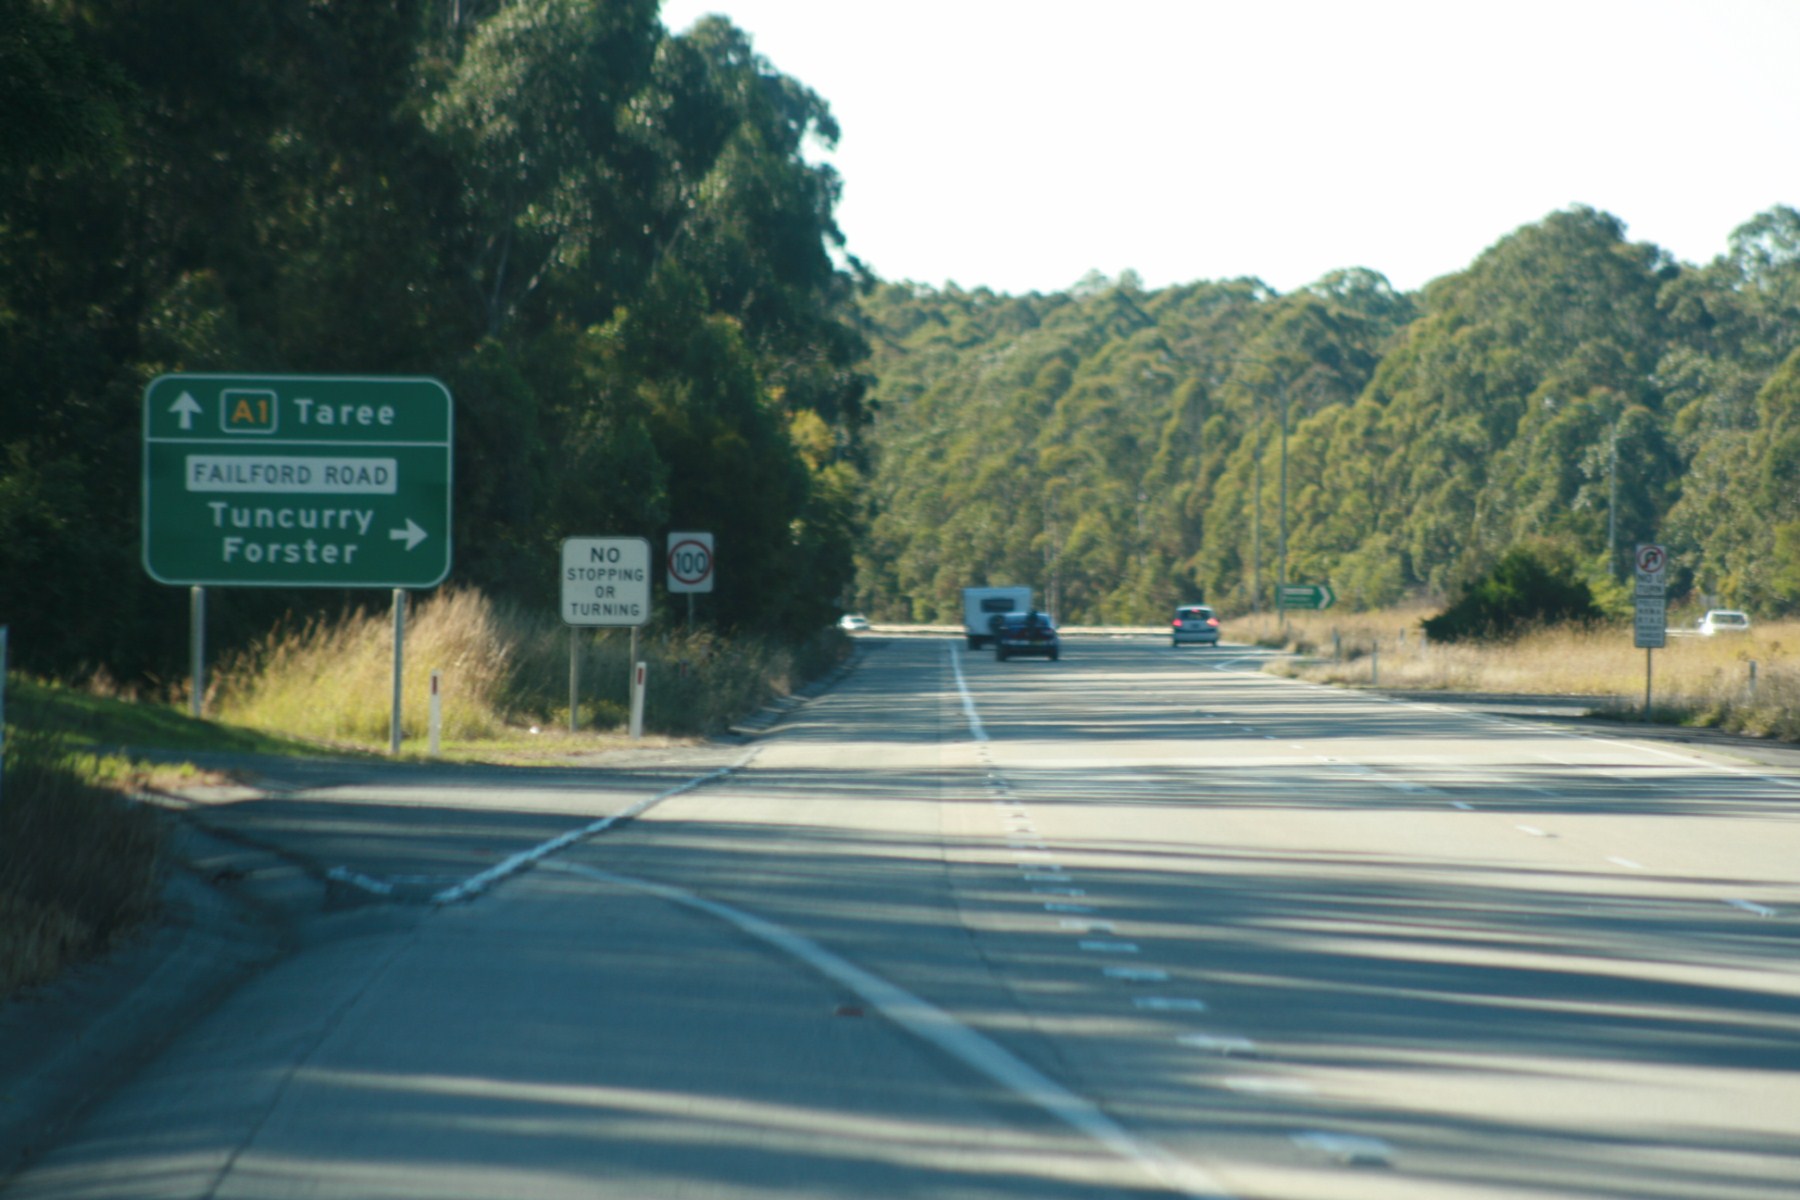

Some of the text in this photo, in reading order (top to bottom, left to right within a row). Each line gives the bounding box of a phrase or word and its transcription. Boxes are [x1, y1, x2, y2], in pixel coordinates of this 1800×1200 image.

[232, 398, 396, 425] A1 Taree
[193, 463, 389, 486] FAILFORD ROAD
[207, 502, 373, 535] Tuncurry
[222, 537, 358, 564] Forster
[590, 547, 621, 563] NO
[675, 552, 707, 574] 100
[567, 568, 644, 582] STOPPING
[595, 585, 616, 599] OR
[570, 603, 640, 616] TURNING
